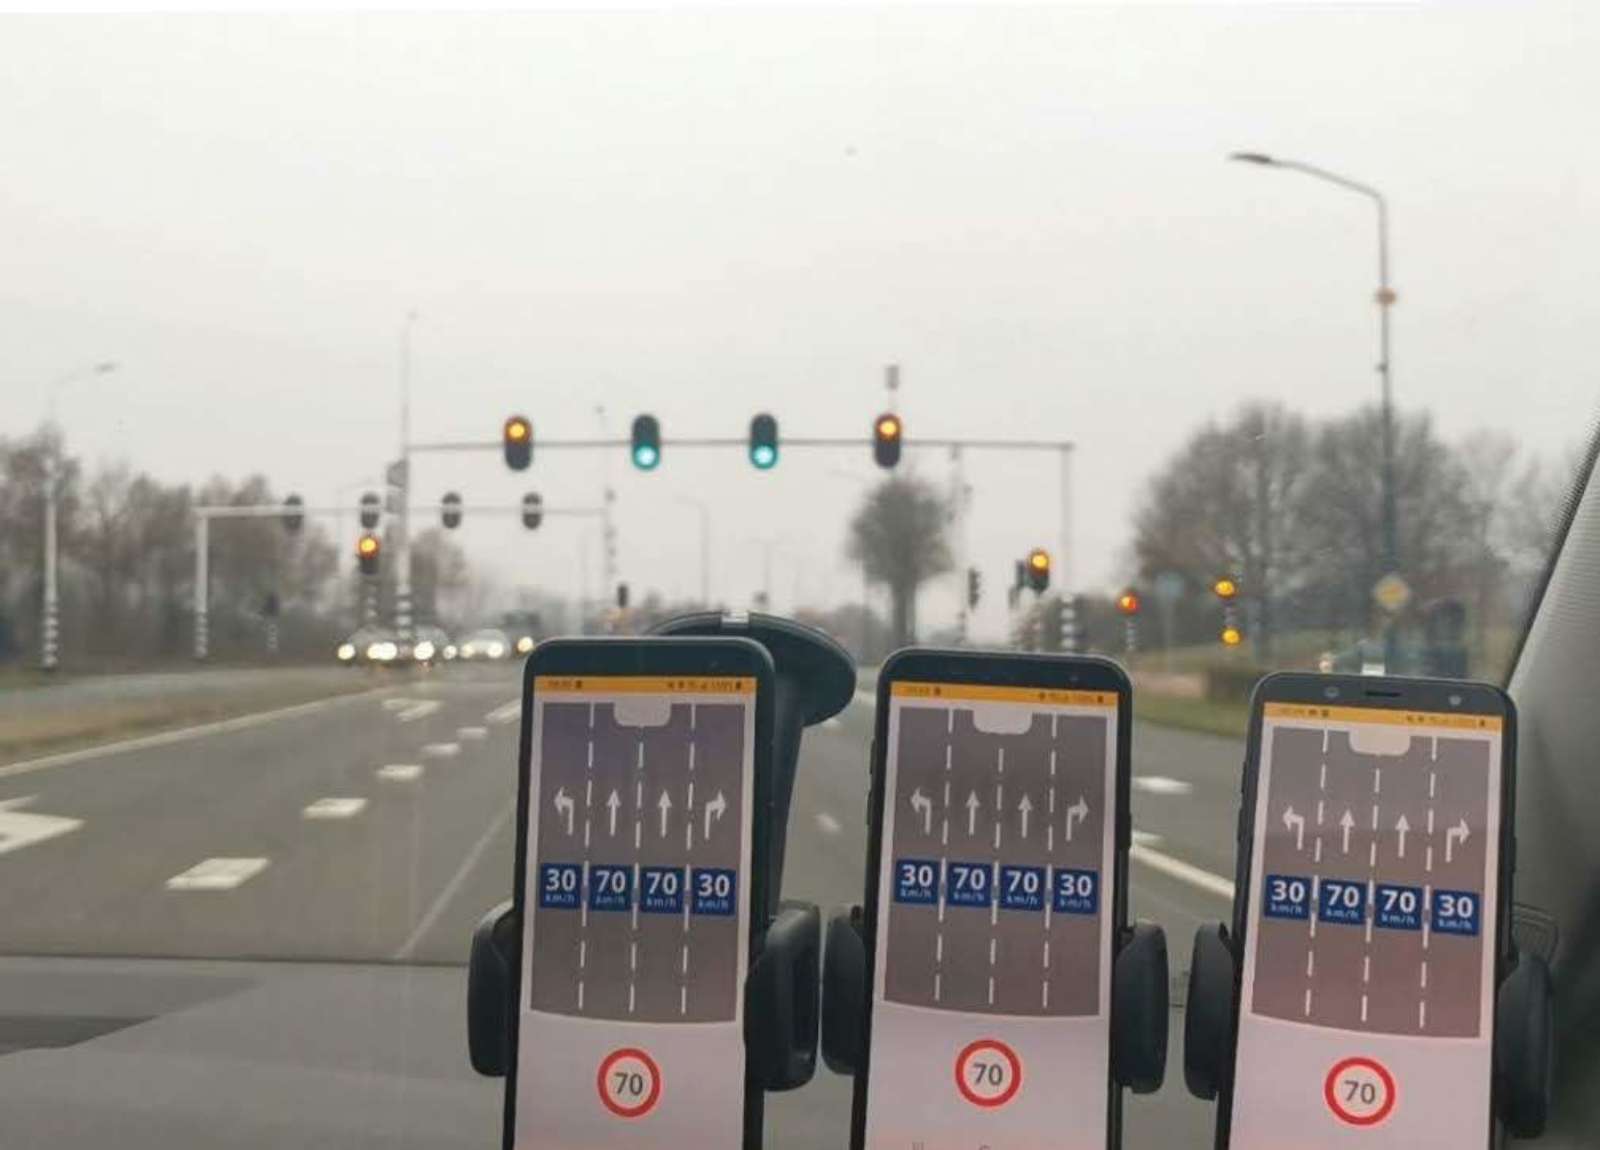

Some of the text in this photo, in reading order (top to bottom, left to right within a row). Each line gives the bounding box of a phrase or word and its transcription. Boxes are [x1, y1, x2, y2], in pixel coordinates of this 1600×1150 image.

[546, 869, 576, 892] 30
[596, 870, 626, 893] 70
[646, 872, 677, 895] 70
[699, 875, 730, 897] 30
[901, 865, 933, 887] 30
[953, 867, 985, 890] 70
[1006, 870, 1038, 893] 70
[1060, 874, 1092, 897] 30
[545, 894, 575, 903] km/h
[596, 895, 625, 905] km/h
[646, 897, 677, 907] km/h
[901, 888, 932, 898] km/h
[953, 891, 984, 901] km/h
[1006, 894, 1038, 905] km/h
[1272, 880, 1305, 903] 30
[1327, 884, 1359, 908] 70
[1381, 889, 1416, 913] 70
[699, 898, 729, 909] km/h
[1060, 898, 1092, 908] km/h
[1271, 903, 1303, 914] km/h
[1326, 908, 1359, 919] km/h
[1439, 894, 1473, 918] 30
[1382, 914, 1415, 925] km/h
[1439, 918, 1472, 929] km/h
[614, 1072, 643, 1096] 70
[972, 1062, 1003, 1086] 70
[1344, 1080, 1376, 1105] 70
